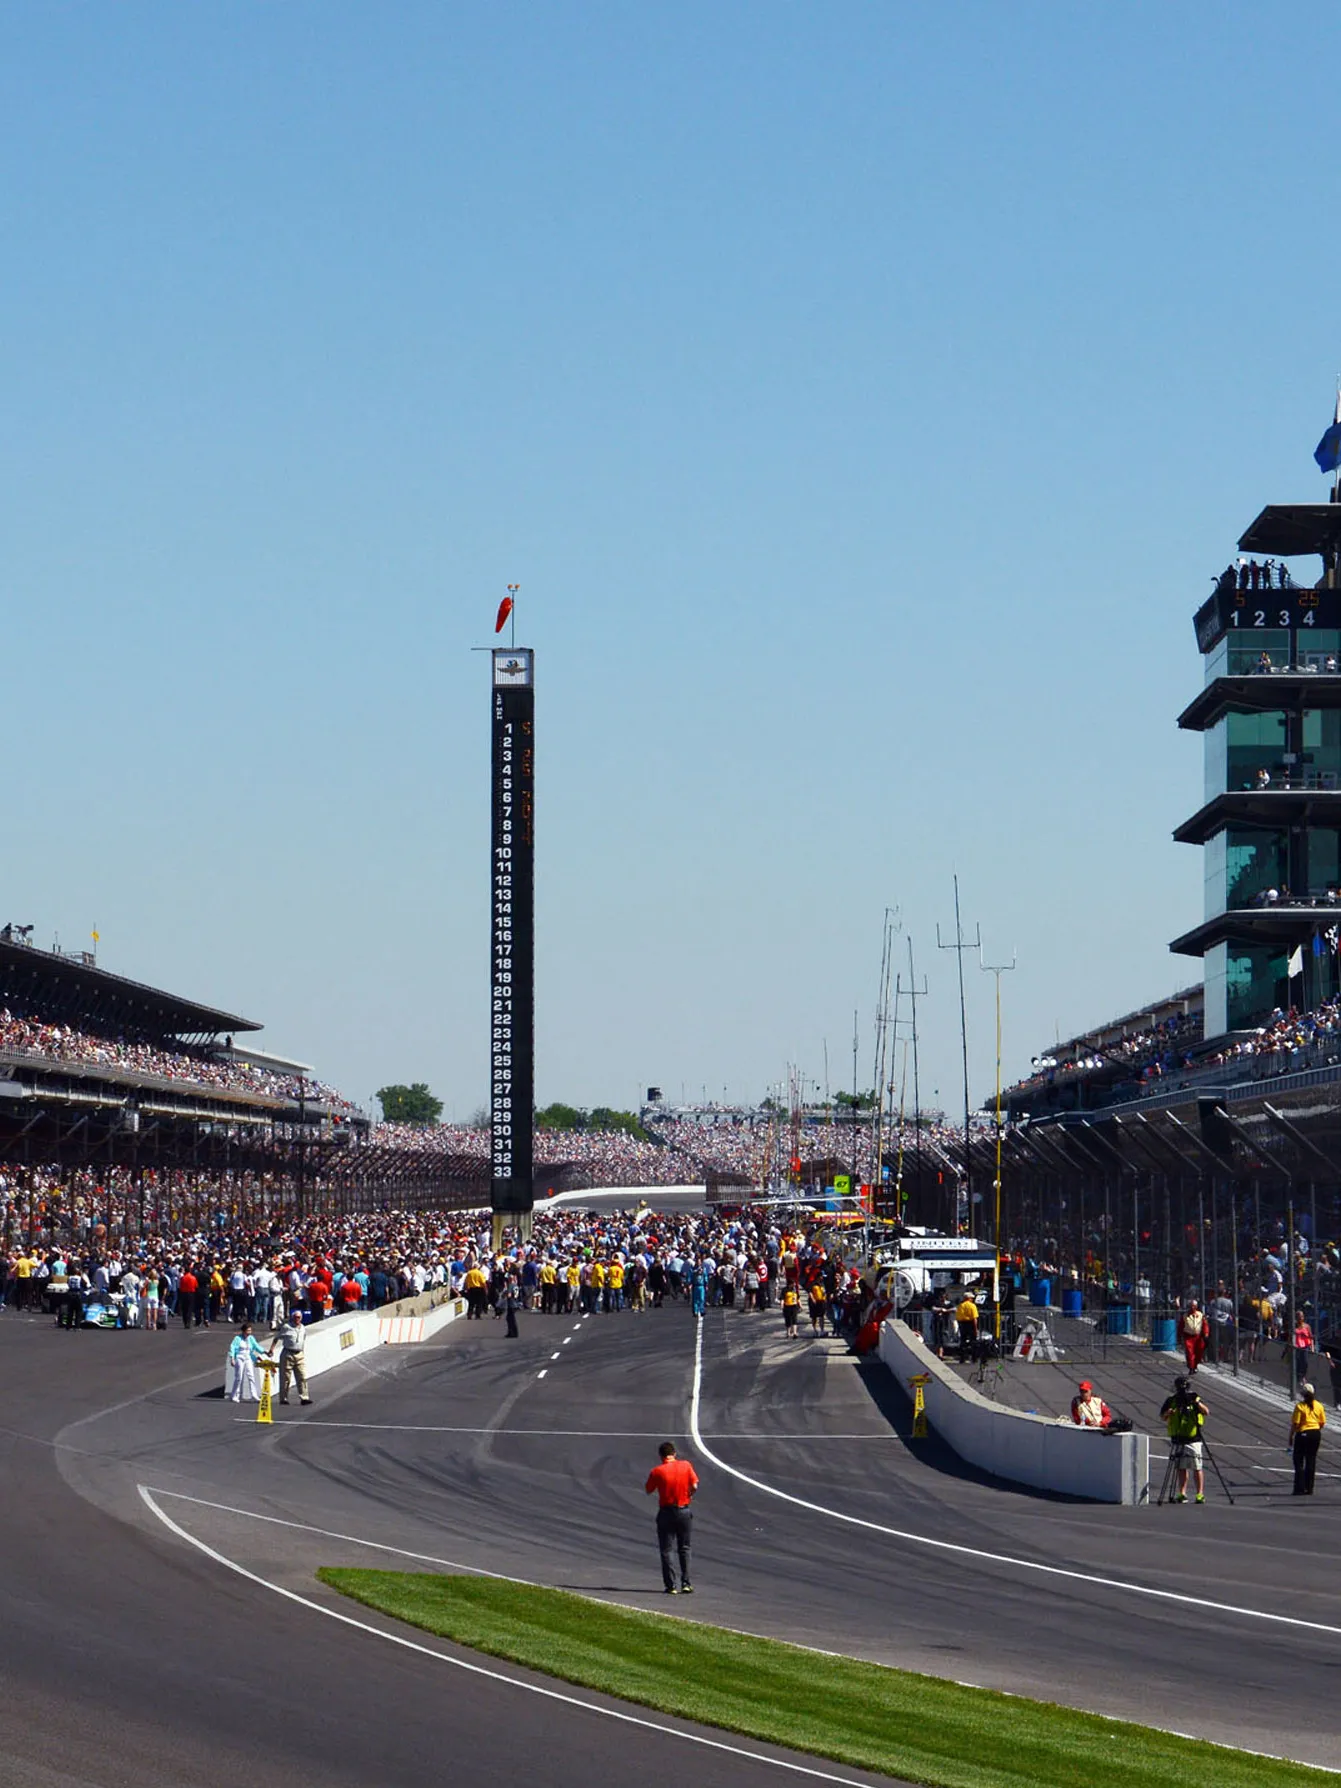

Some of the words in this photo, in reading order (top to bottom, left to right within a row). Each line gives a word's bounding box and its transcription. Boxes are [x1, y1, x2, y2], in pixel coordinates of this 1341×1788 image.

[1230, 611, 1239, 626] 1
[1254, 610, 1265, 626] 2
[1279, 610, 1290, 626] 3
[1303, 611, 1315, 626] 4
[504, 723, 513, 733] 1
[502, 736, 512, 747] 2
[503, 750, 512, 761] 3
[502, 764, 512, 775] 4
[503, 778, 512, 789] 5
[502, 791, 512, 802] 6
[502, 806, 512, 816] 7
[502, 819, 512, 830] 8
[502, 833, 512, 844] 9
[495, 847, 512, 858] 10
[496, 861, 512, 872] 11
[495, 875, 512, 886] 12
[494, 888, 512, 900] 13
[494, 902, 512, 913] 14
[494, 916, 512, 927] 15
[494, 930, 512, 941] 16
[494, 944, 512, 955] 17
[494, 958, 512, 969] 18
[494, 971, 512, 983] 19
[493, 985, 512, 996] 20
[493, 999, 512, 1010] 21
[493, 1013, 512, 1024] 22
[493, 1027, 512, 1038] 23
[492, 1041, 512, 1052] 24
[493, 1054, 512, 1066] 25
[493, 1069, 512, 1080] 26
[493, 1082, 512, 1094] 27
[493, 1097, 512, 1108] 28
[493, 1110, 512, 1122] 29
[493, 1124, 512, 1135] 30
[493, 1138, 512, 1149] 31
[493, 1152, 512, 1163] 32
[493, 1165, 512, 1177] 33
[836, 1181, 848, 1189] 67
